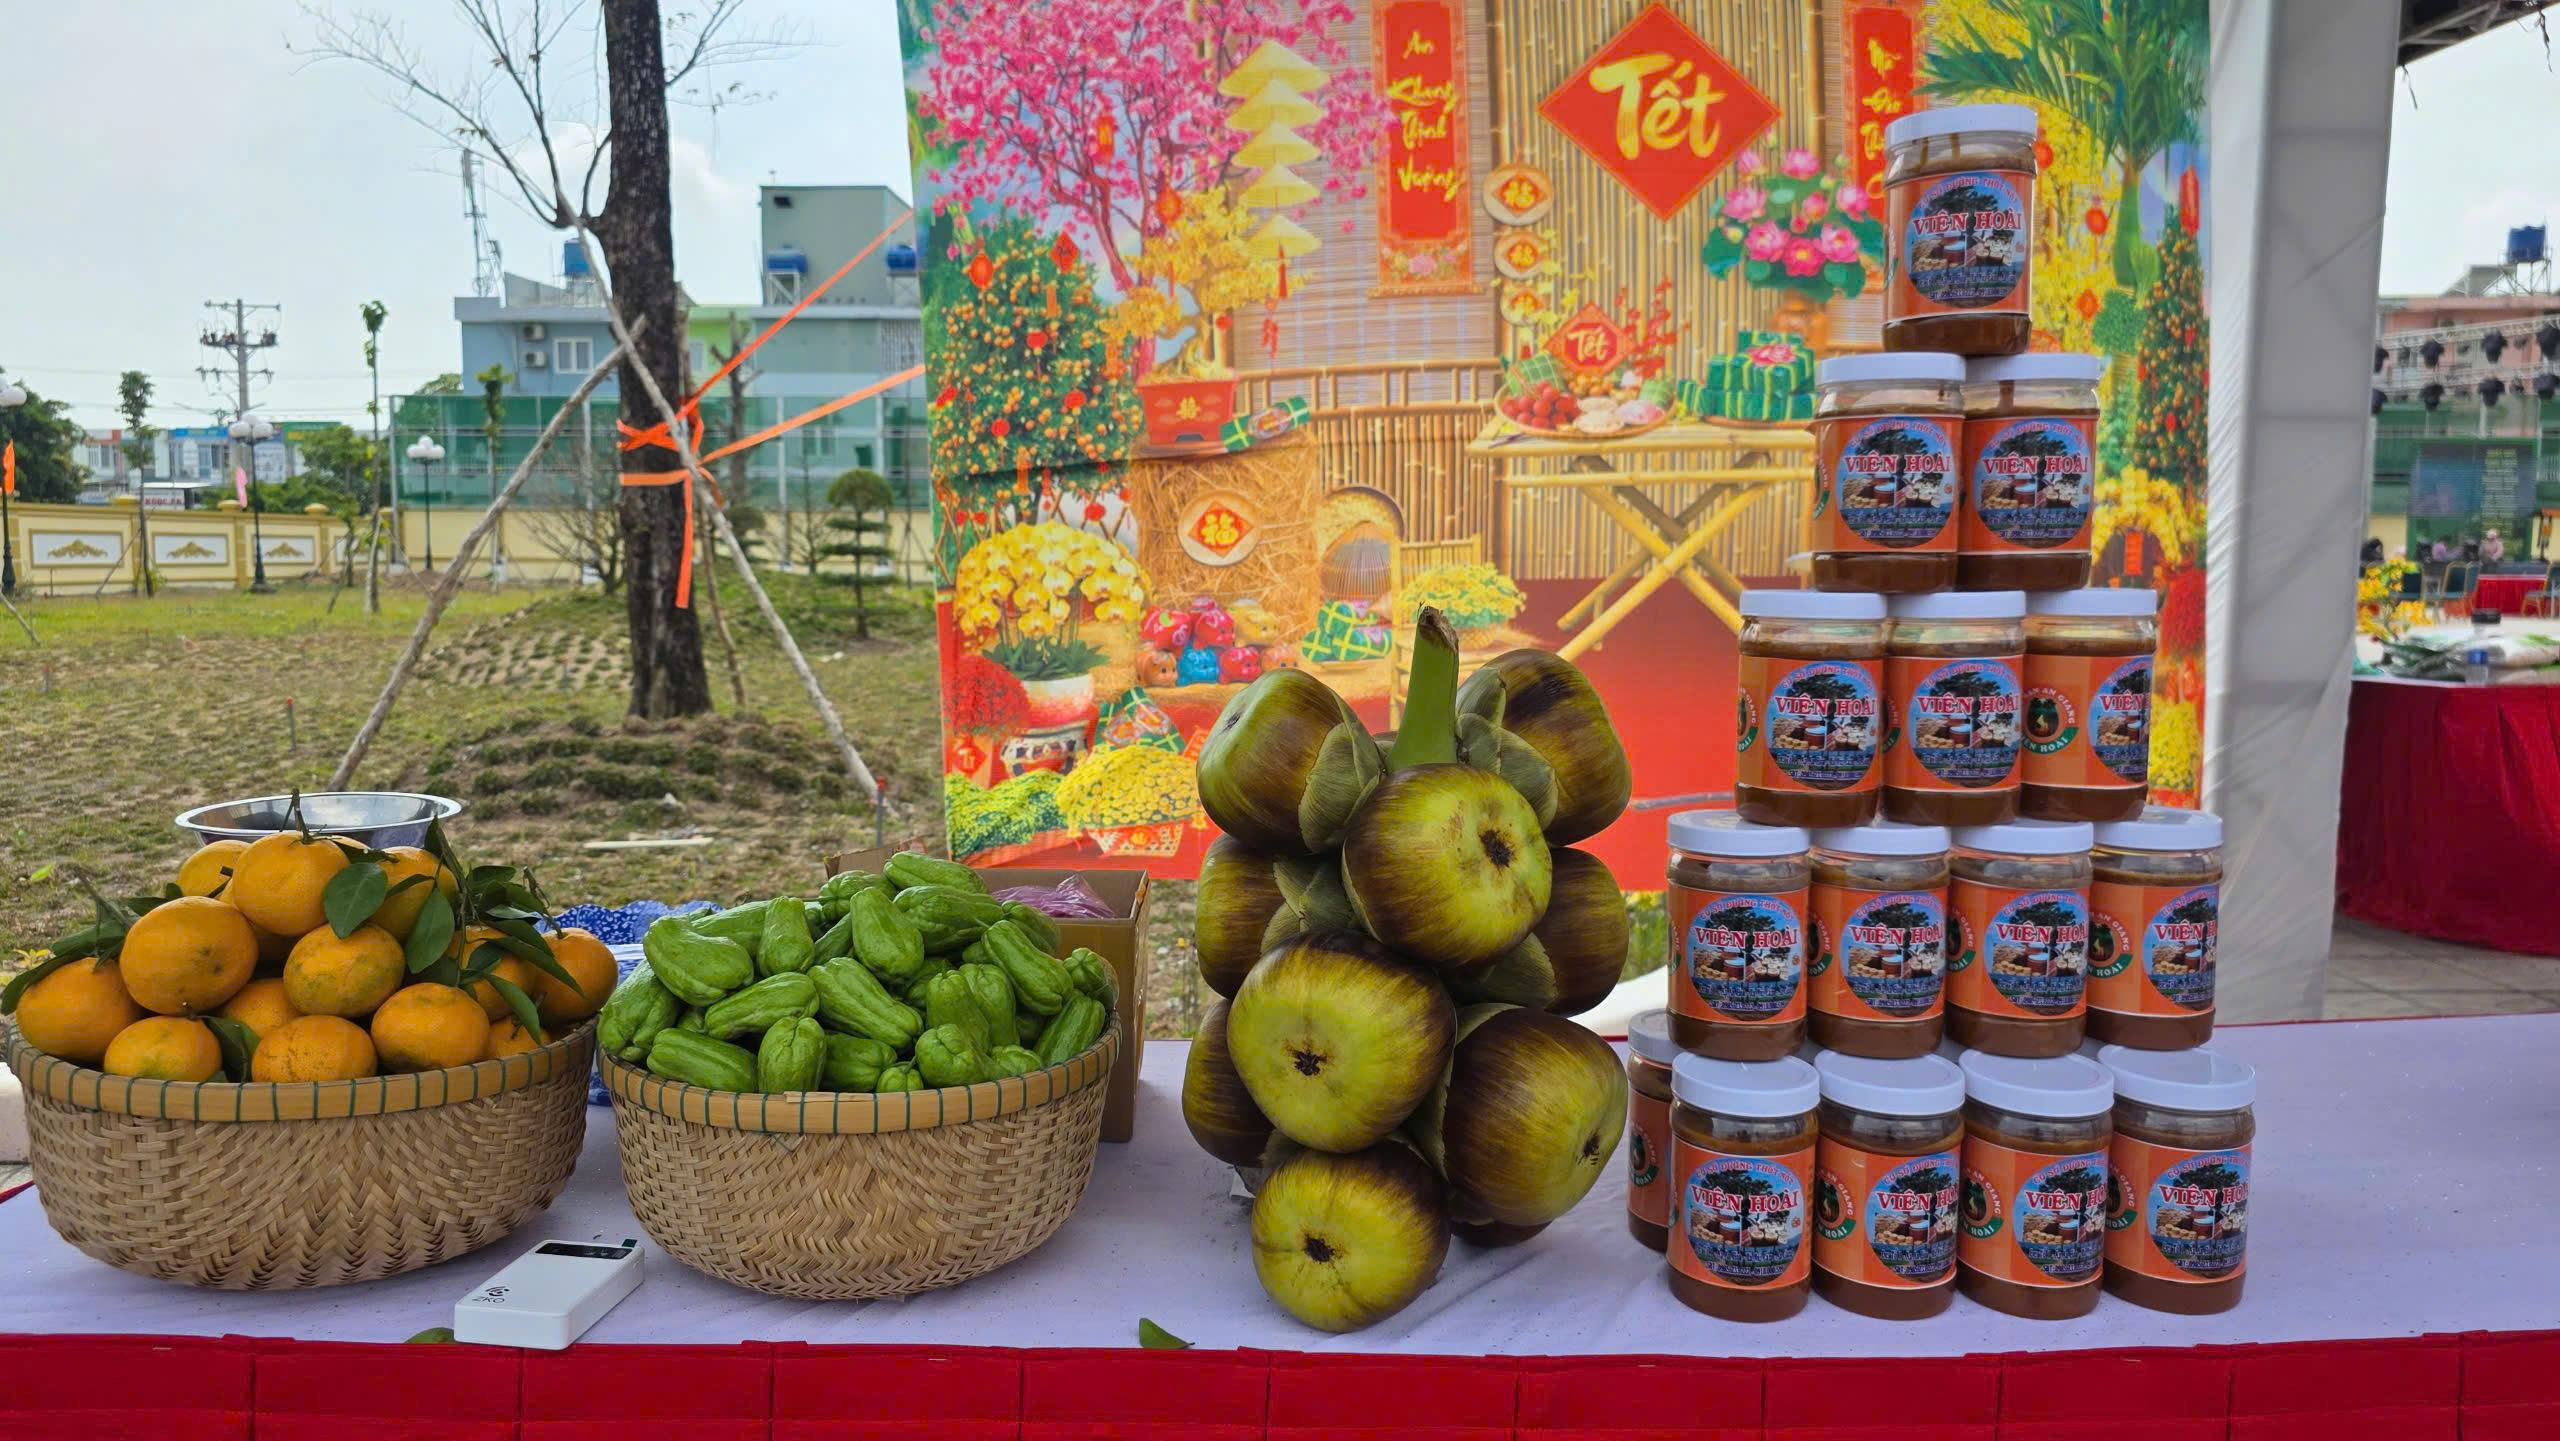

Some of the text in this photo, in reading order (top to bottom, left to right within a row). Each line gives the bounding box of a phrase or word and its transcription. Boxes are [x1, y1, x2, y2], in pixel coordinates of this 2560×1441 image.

[1589, 52, 1727, 159] Tết
[1913, 208, 2021, 235] VIÊN HOÀI
[1845, 450, 1950, 473] VIÊN HOÀI
[1983, 450, 2088, 474] VIÊN HOÀI
[1775, 693, 1829, 716] VIÊN
[1918, 693, 1973, 713] VIÊN
[2100, 689, 2145, 711] VIÊN
[1695, 925, 1798, 948] VIÊN HOÀI
[1850, 922, 1904, 944] VIÊN
[1996, 921, 2051, 943] VIÊN
[2153, 919, 2204, 940] VIÊN
[1691, 1184, 1799, 1213] VIÊN HOÀI
[1877, 1188, 1932, 1211] VIÊN
[2026, 1187, 2081, 1211] VIÊN
[2160, 1184, 2217, 1206] VIÊN
